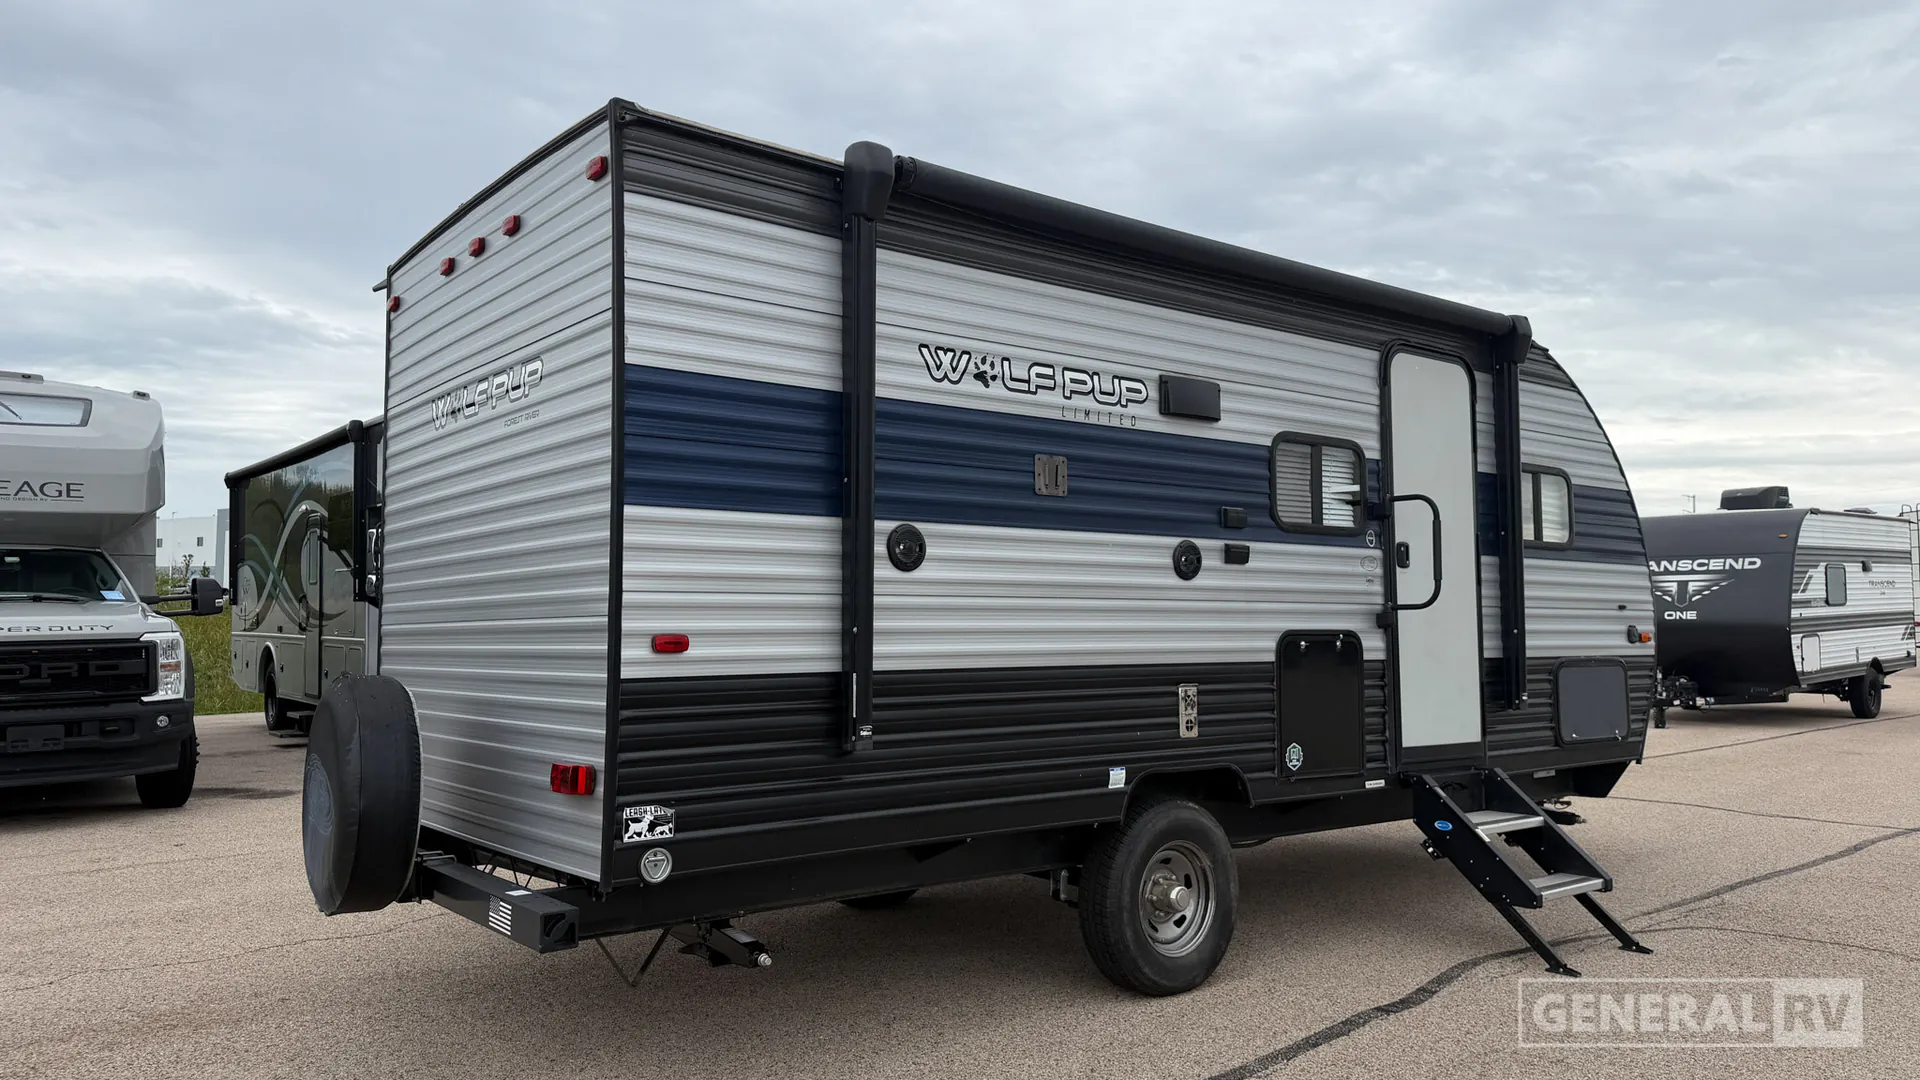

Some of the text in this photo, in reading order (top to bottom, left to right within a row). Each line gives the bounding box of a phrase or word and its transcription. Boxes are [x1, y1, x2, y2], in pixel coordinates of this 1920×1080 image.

[490, 356, 544, 410] PUP
[1062, 367, 1149, 408] PUP
[1062, 406, 1137, 427] LIMITED
[1664, 611, 1698, 620] ONE
[48, 624, 114, 632] DUTY
